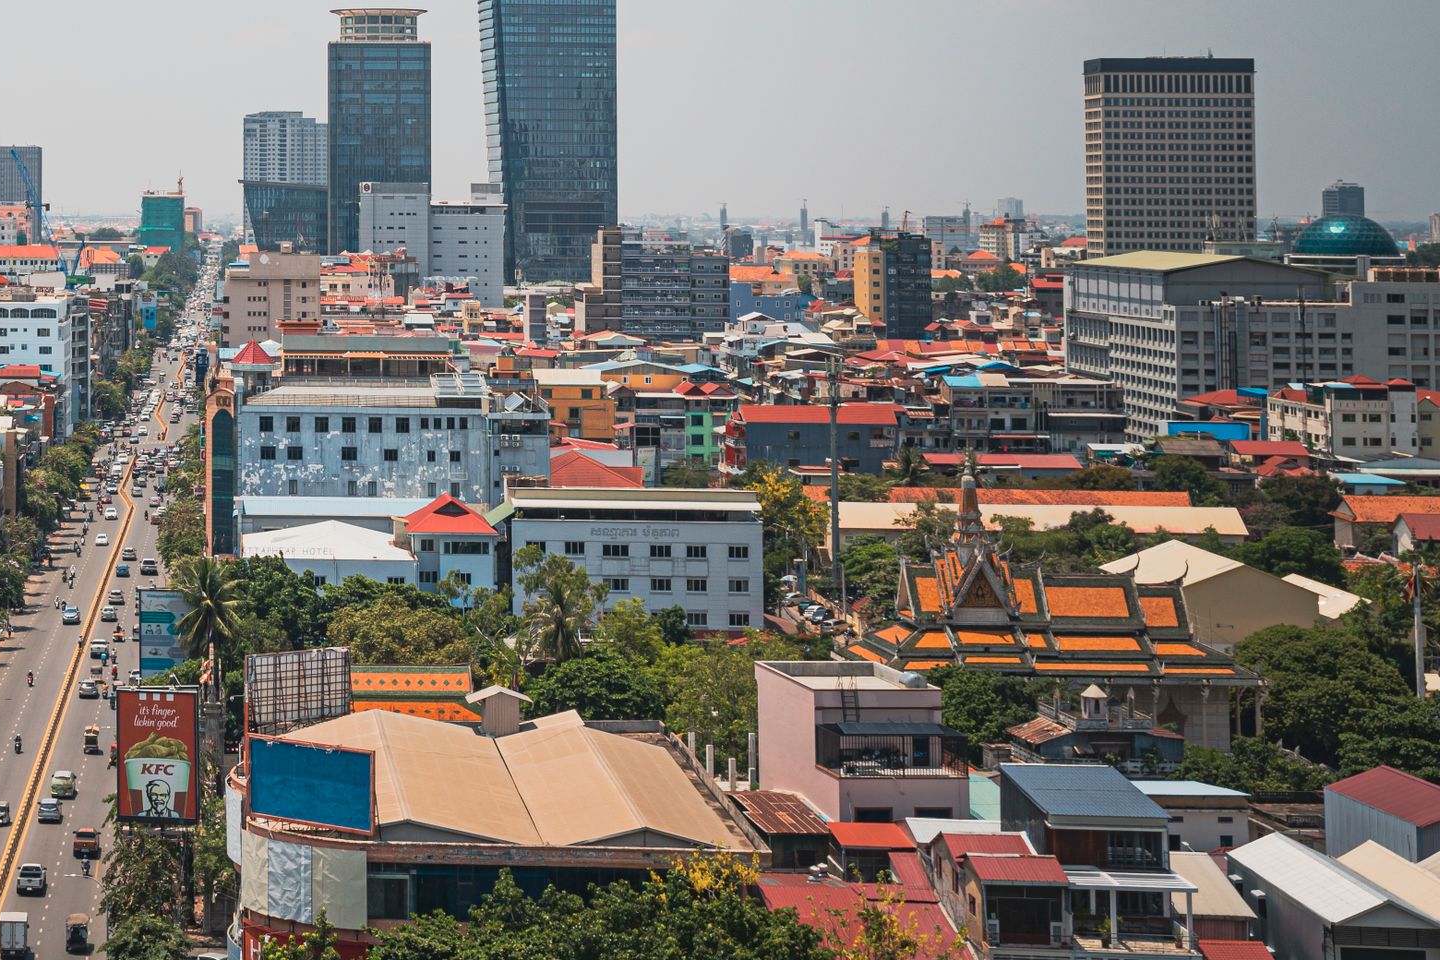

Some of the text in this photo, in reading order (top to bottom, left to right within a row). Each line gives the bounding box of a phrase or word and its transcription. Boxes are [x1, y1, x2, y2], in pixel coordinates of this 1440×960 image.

[302, 547, 334, 556] HOTEL
[151, 704, 176, 719] finger
[141, 764, 175, 776] KFC
